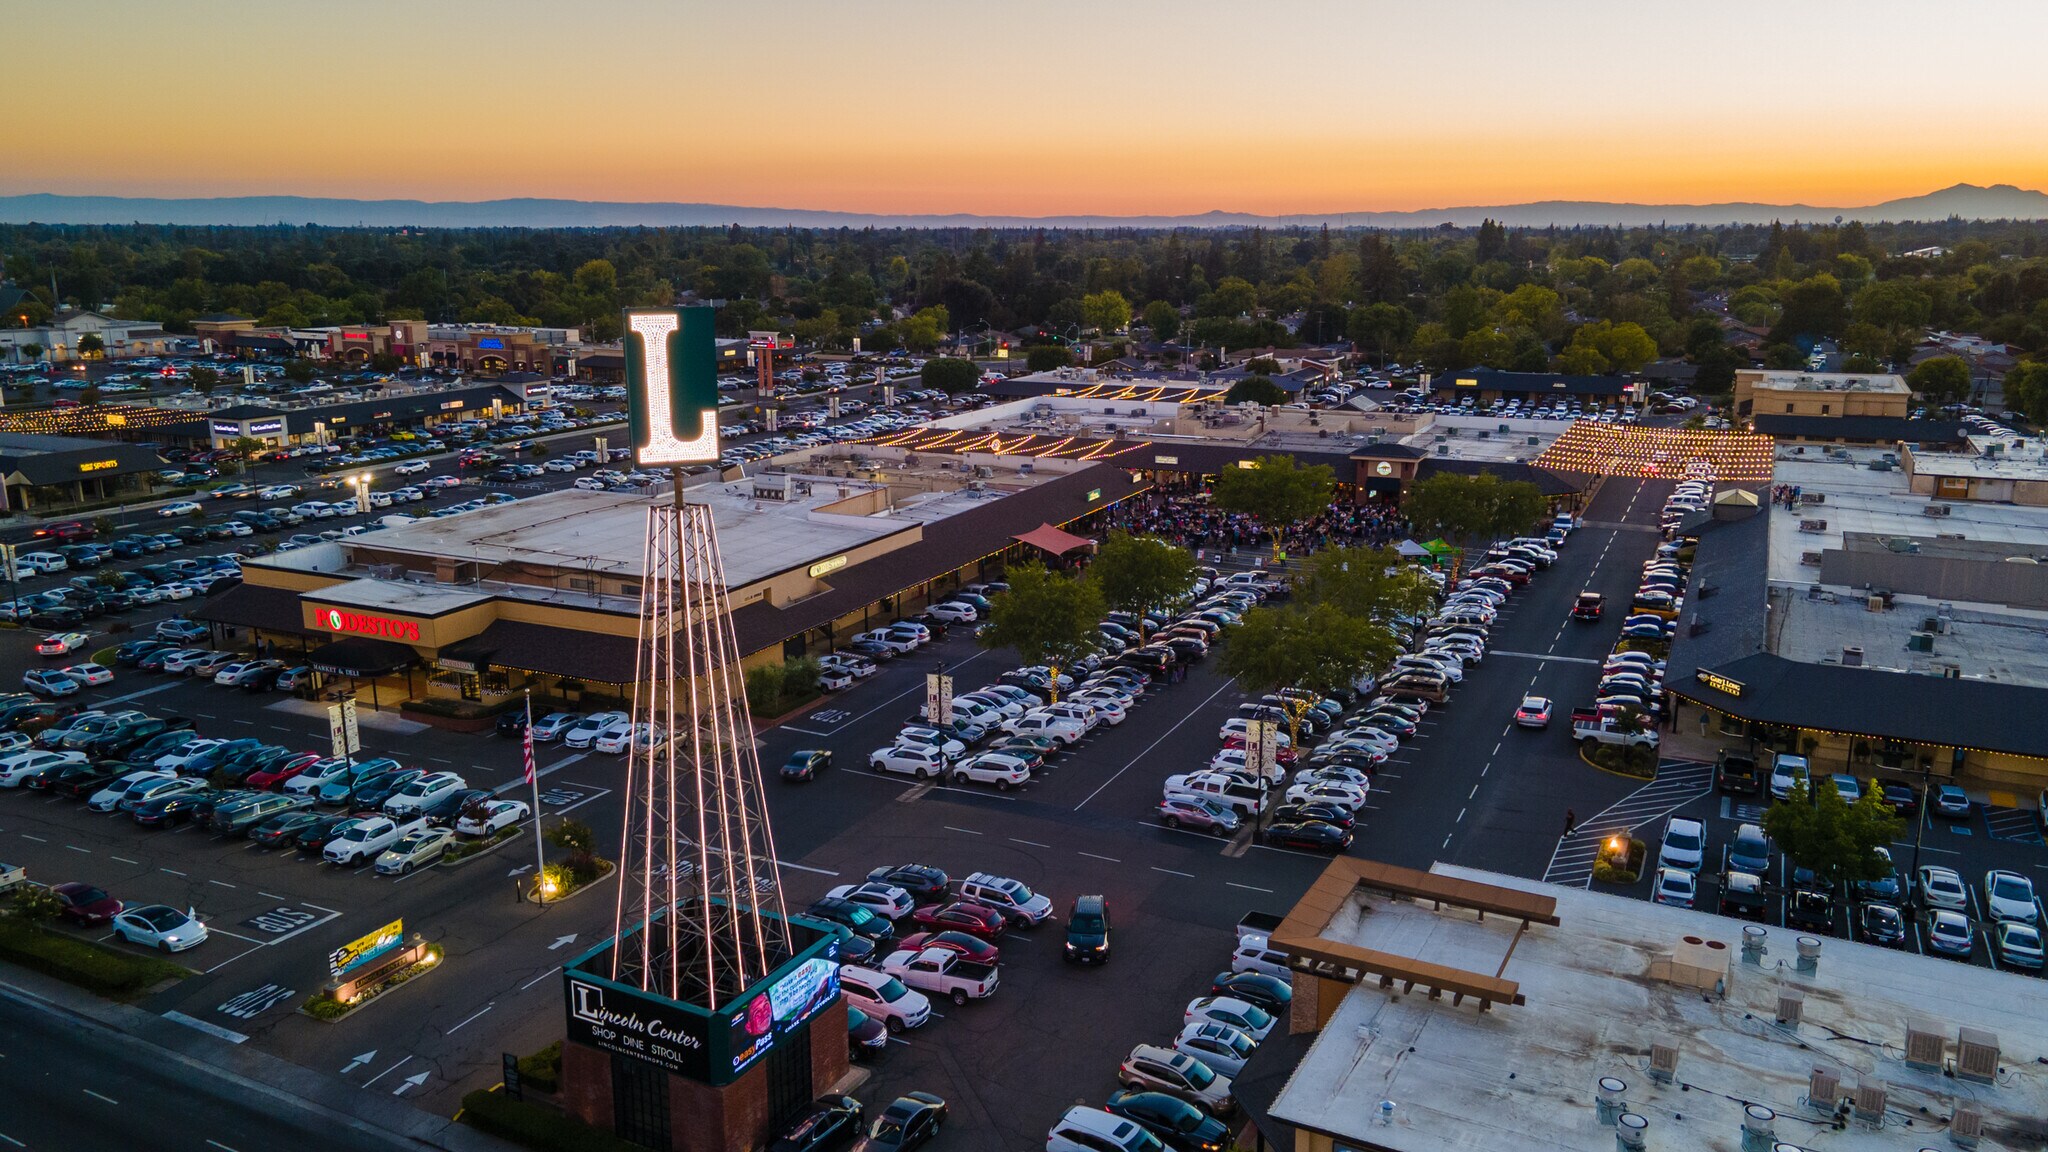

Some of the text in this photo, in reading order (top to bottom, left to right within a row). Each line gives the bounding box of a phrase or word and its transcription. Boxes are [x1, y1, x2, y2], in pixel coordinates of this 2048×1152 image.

[629, 313, 720, 464] L
[94, 460, 118, 469] SPORTS
[314, 608, 420, 641] PODESTO'S
[313, 663, 337, 674] MARKET
[345, 669, 360, 677] DELI
[249, 907, 315, 933] STOP
[577, 987, 702, 1050] Lincoln Center
[592, 1025, 684, 1064] SHOP DINE STROLL
[598, 1040, 679, 1071] LINCOLNCENTERSHOPS.COM
